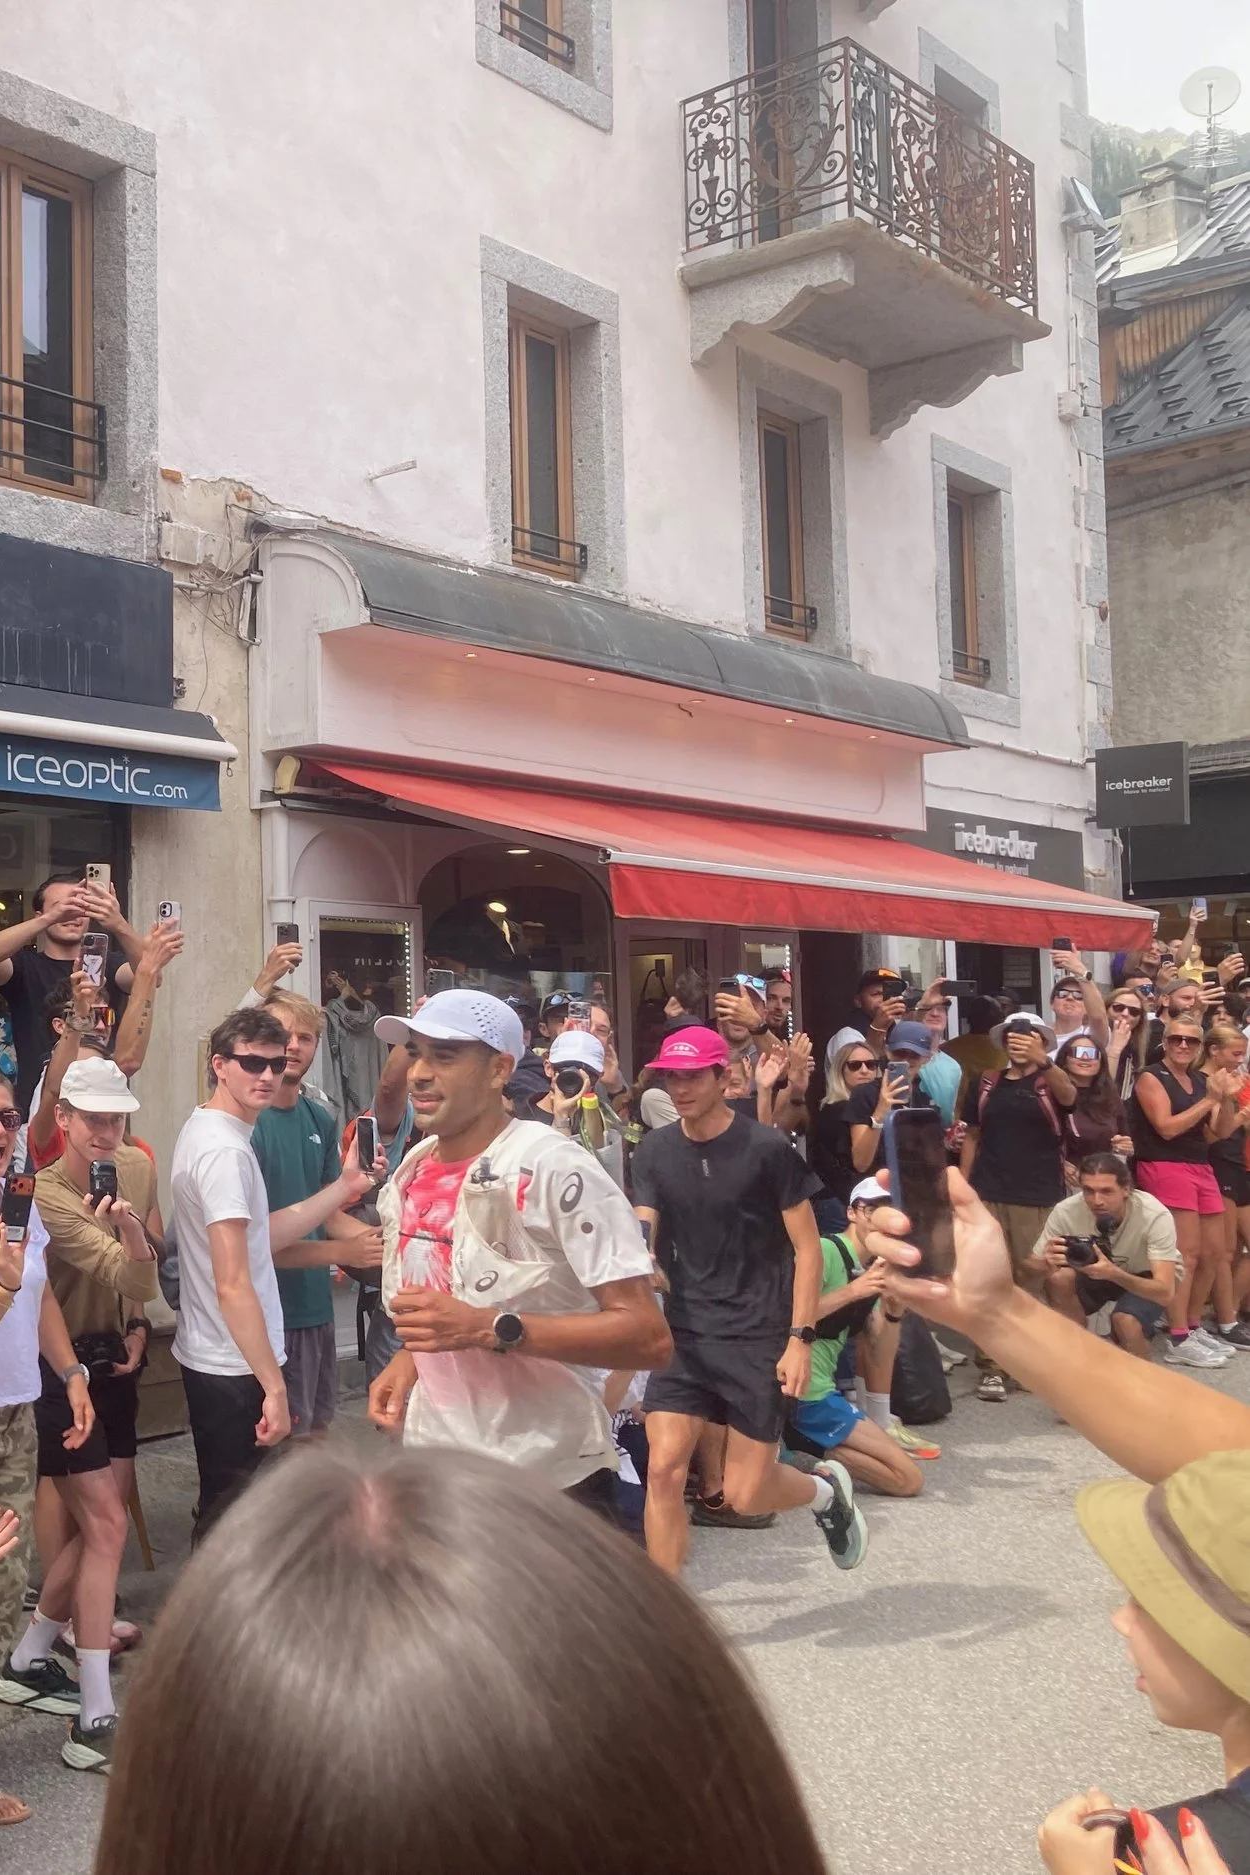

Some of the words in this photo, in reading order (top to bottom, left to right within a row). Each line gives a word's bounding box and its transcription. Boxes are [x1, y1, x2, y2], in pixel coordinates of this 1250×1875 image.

[5, 744, 189, 800] iceoptic.com
[1105, 776, 1173, 791] icebreaker
[954, 823, 1037, 860] icebreaker
